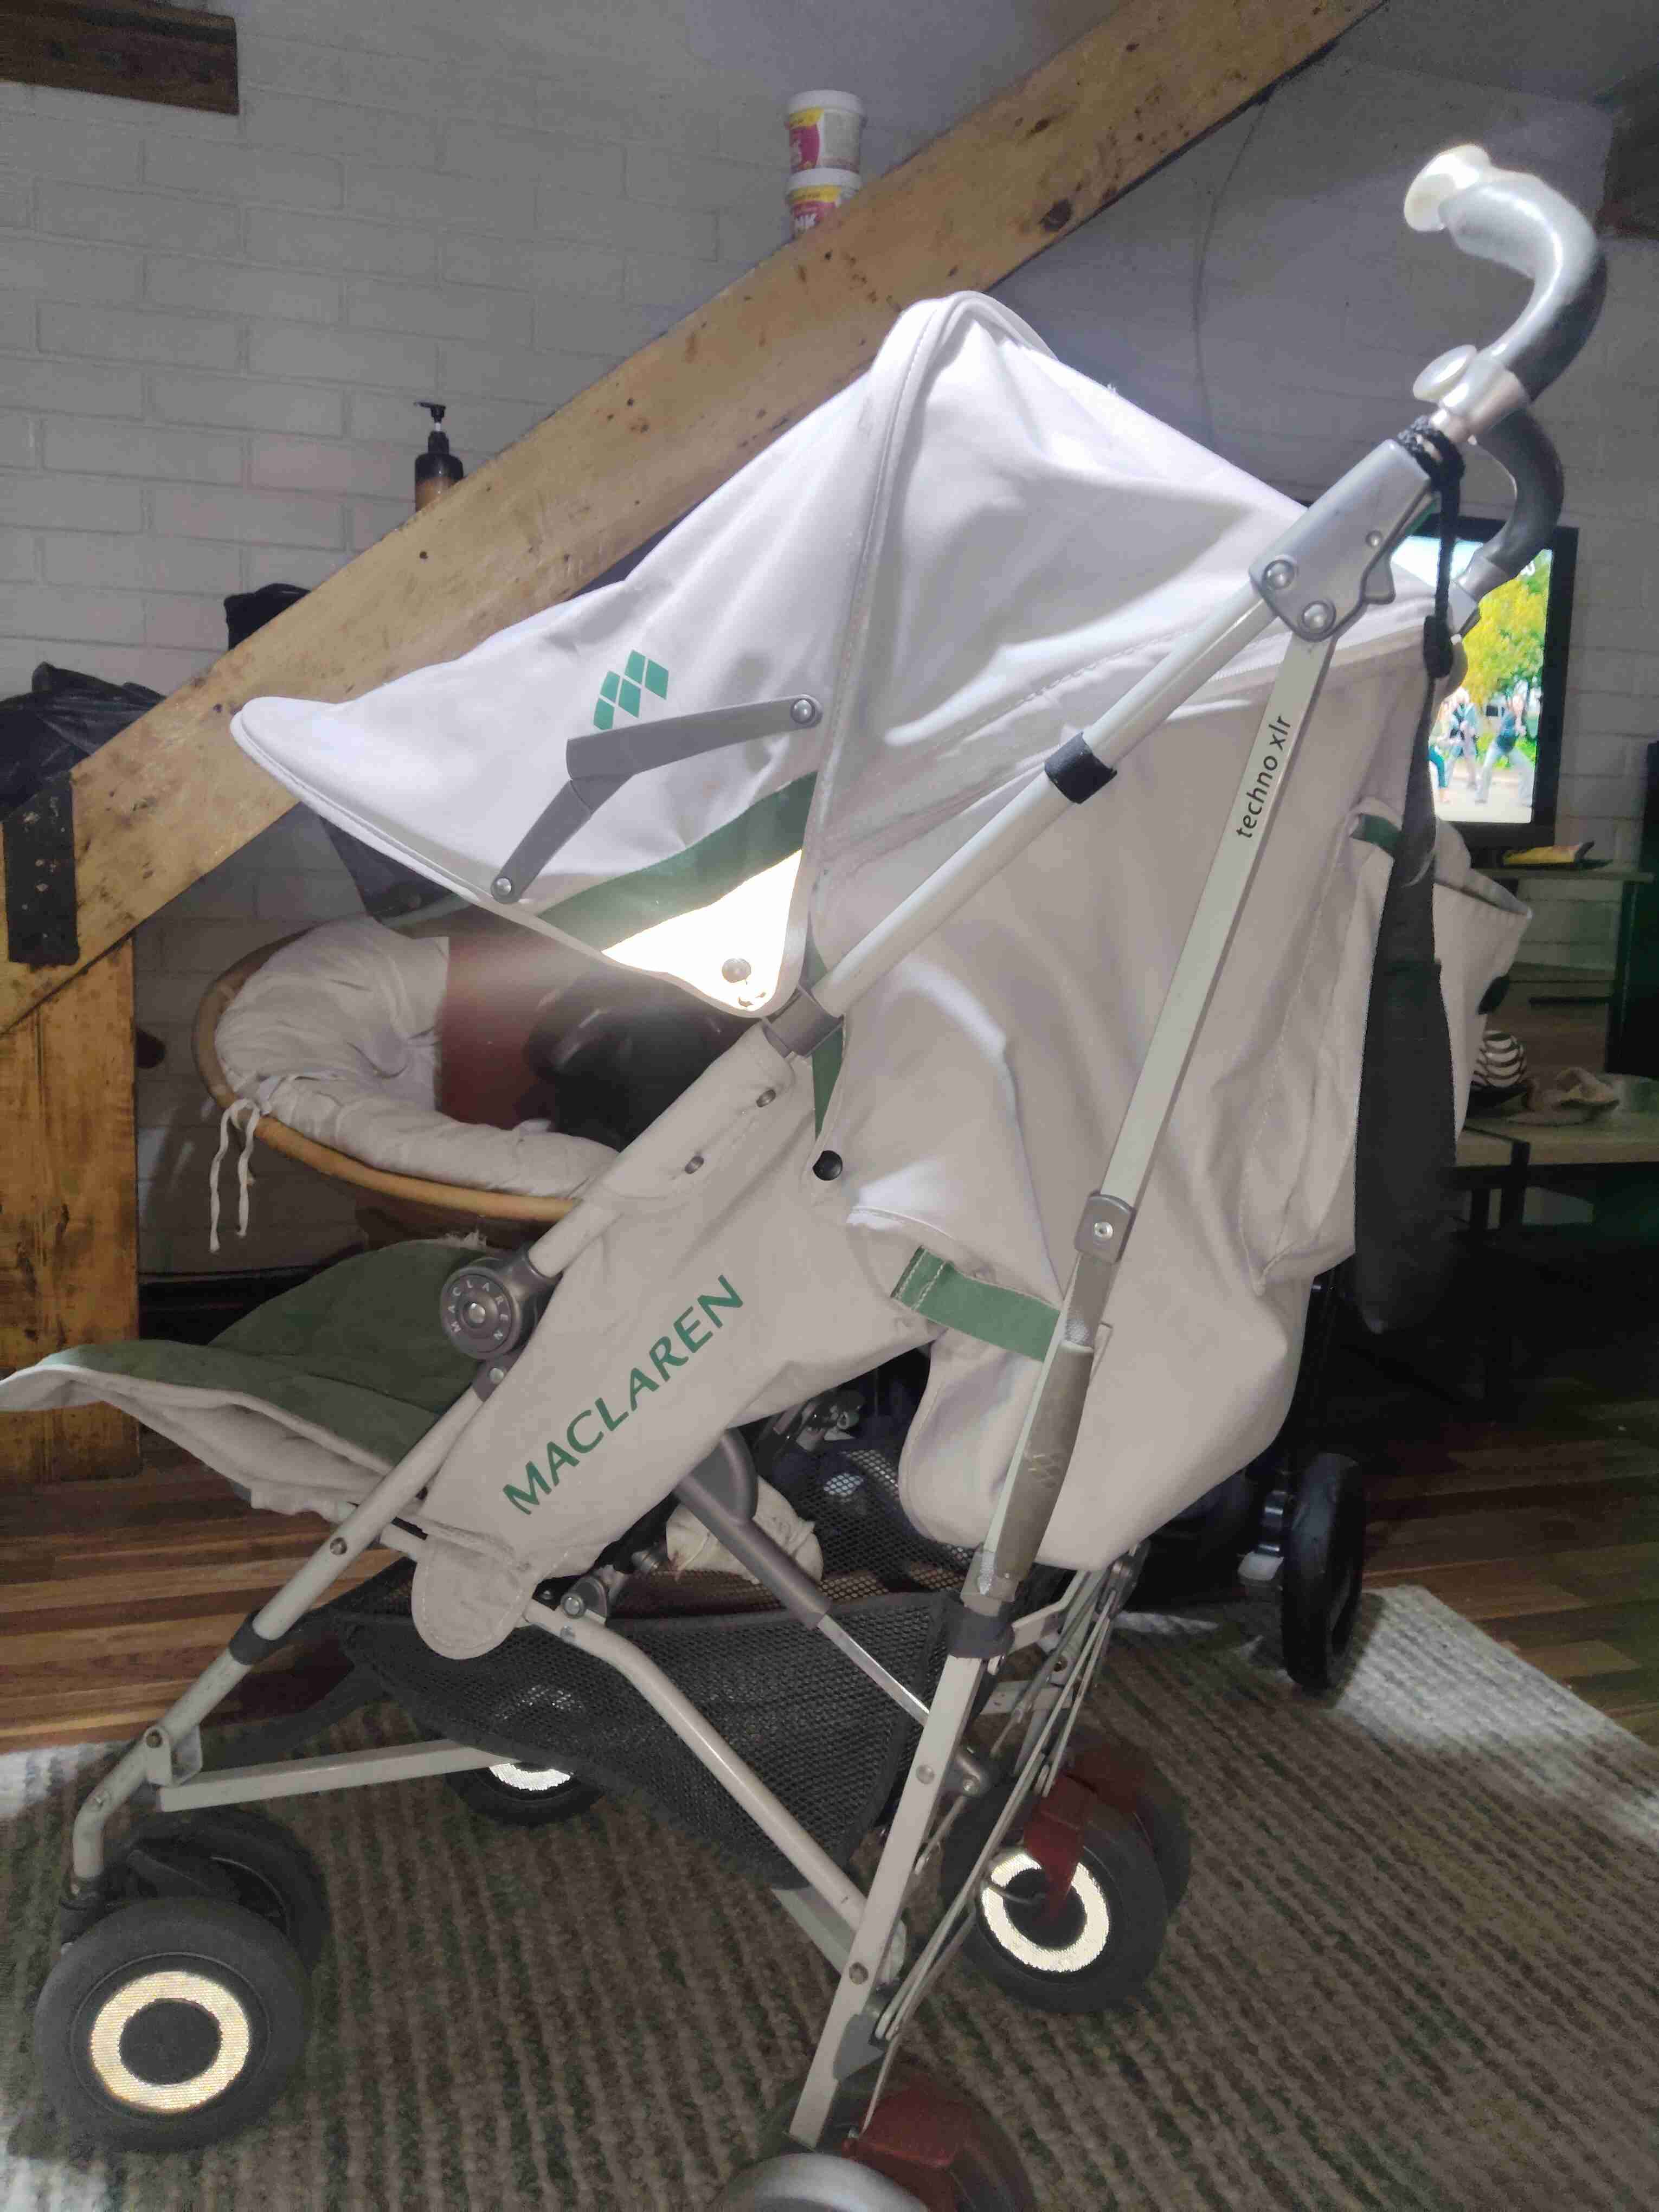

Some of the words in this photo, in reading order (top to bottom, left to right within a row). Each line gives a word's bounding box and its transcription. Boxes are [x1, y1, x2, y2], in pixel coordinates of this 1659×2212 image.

[1236, 755, 1278, 838] techno
[1268, 715, 1291, 751] xlr
[447, 1280, 509, 1341] MACLAREN
[502, 1275, 743, 1515] MACLAREN
